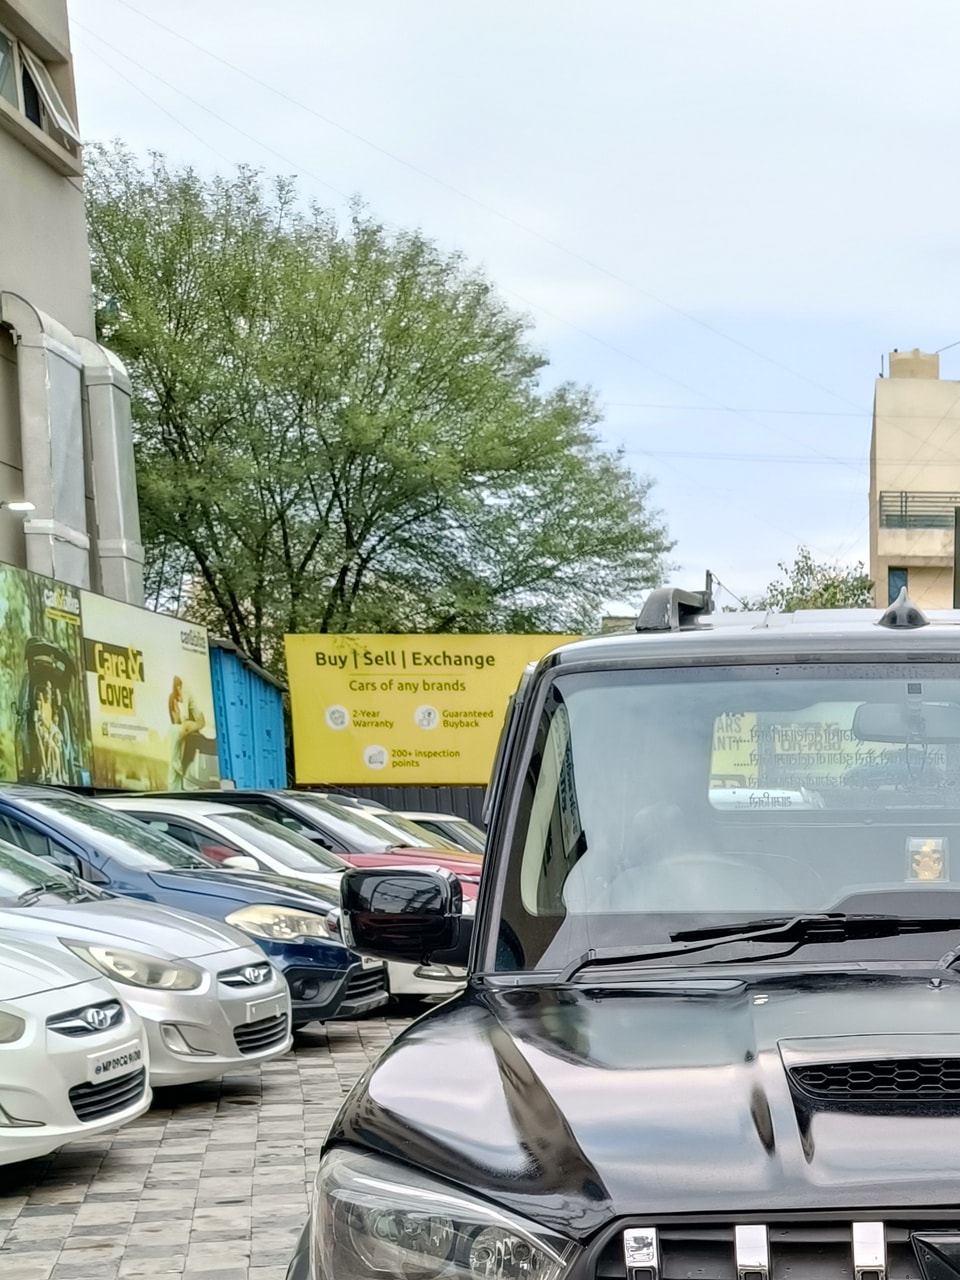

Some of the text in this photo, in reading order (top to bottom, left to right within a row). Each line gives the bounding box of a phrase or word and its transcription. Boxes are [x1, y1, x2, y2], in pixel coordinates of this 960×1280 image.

[94, 643, 127, 679] Care
[315, 652, 347, 669] Buy
[363, 651, 397, 666] Sell
[412, 650, 496, 669] Exchange
[349, 679, 466, 694] Cars of any brands
[98, 674, 134, 709] Cover
[352, 710, 380, 718] 2-Year
[442, 709, 494, 718] Guaranteed
[353, 720, 394, 729] Warranty
[443, 720, 480, 729] Buyback
[414, 749, 460, 759] inspection
[392, 760, 420, 768] points
